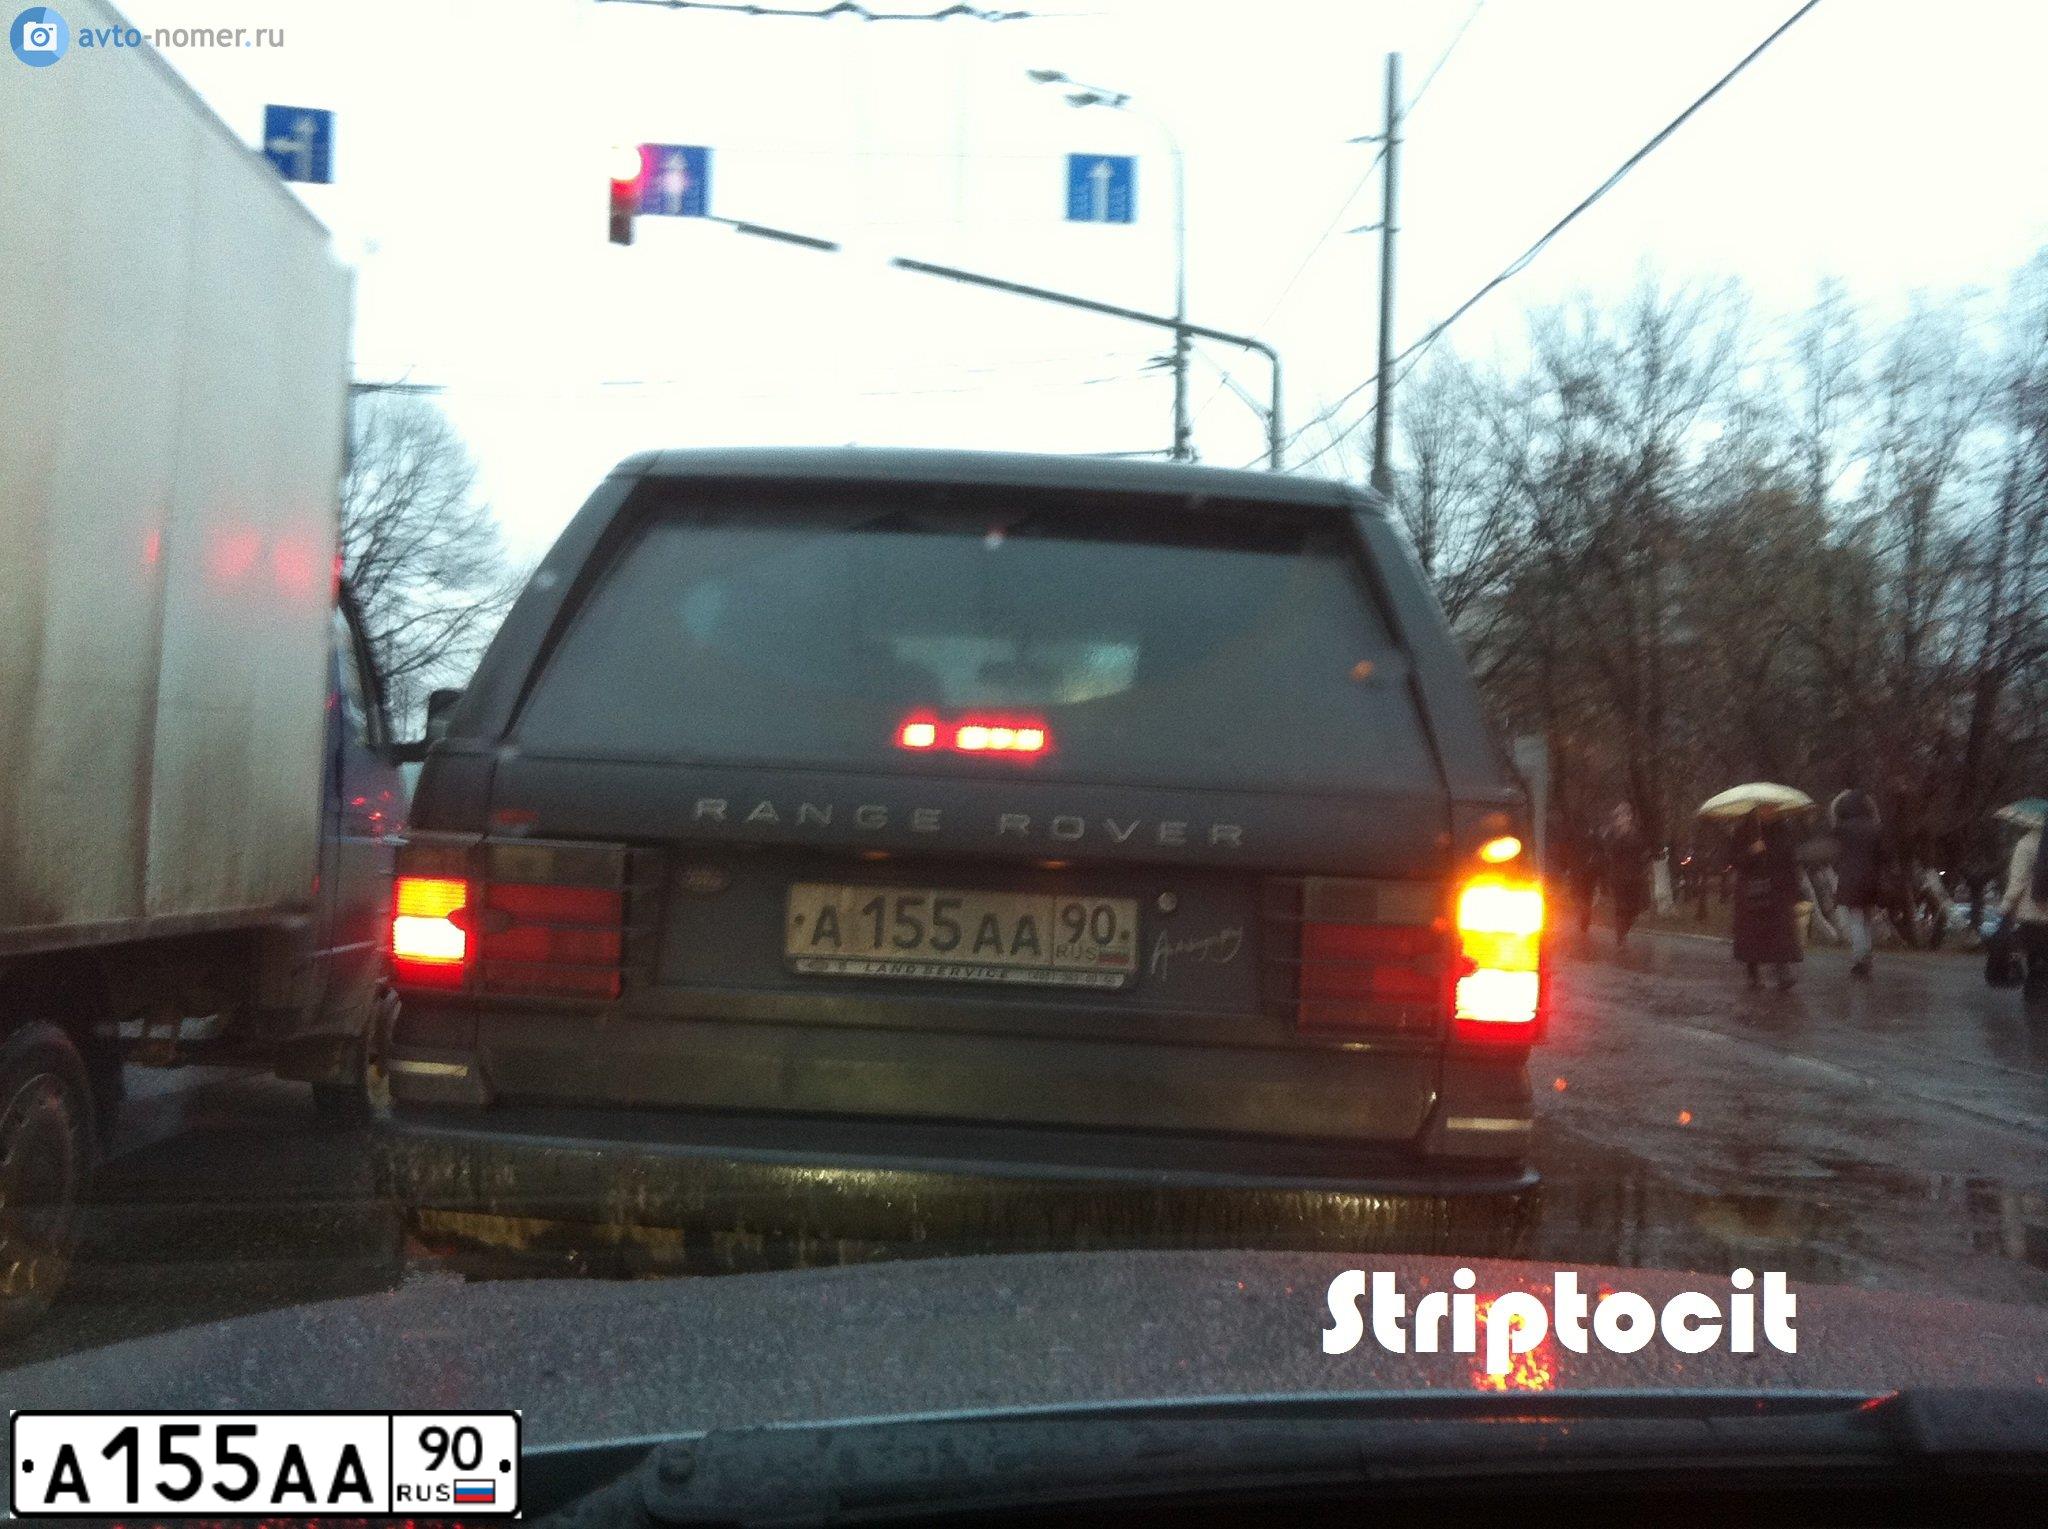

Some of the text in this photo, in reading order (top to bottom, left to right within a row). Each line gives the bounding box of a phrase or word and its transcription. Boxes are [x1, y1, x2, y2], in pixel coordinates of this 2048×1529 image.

[695, 798, 1244, 847] RANGE ROVER
[1060, 902, 1117, 945] 90
[1056, 945, 1097, 961] RUS
[864, 962, 917, 976] LAND
